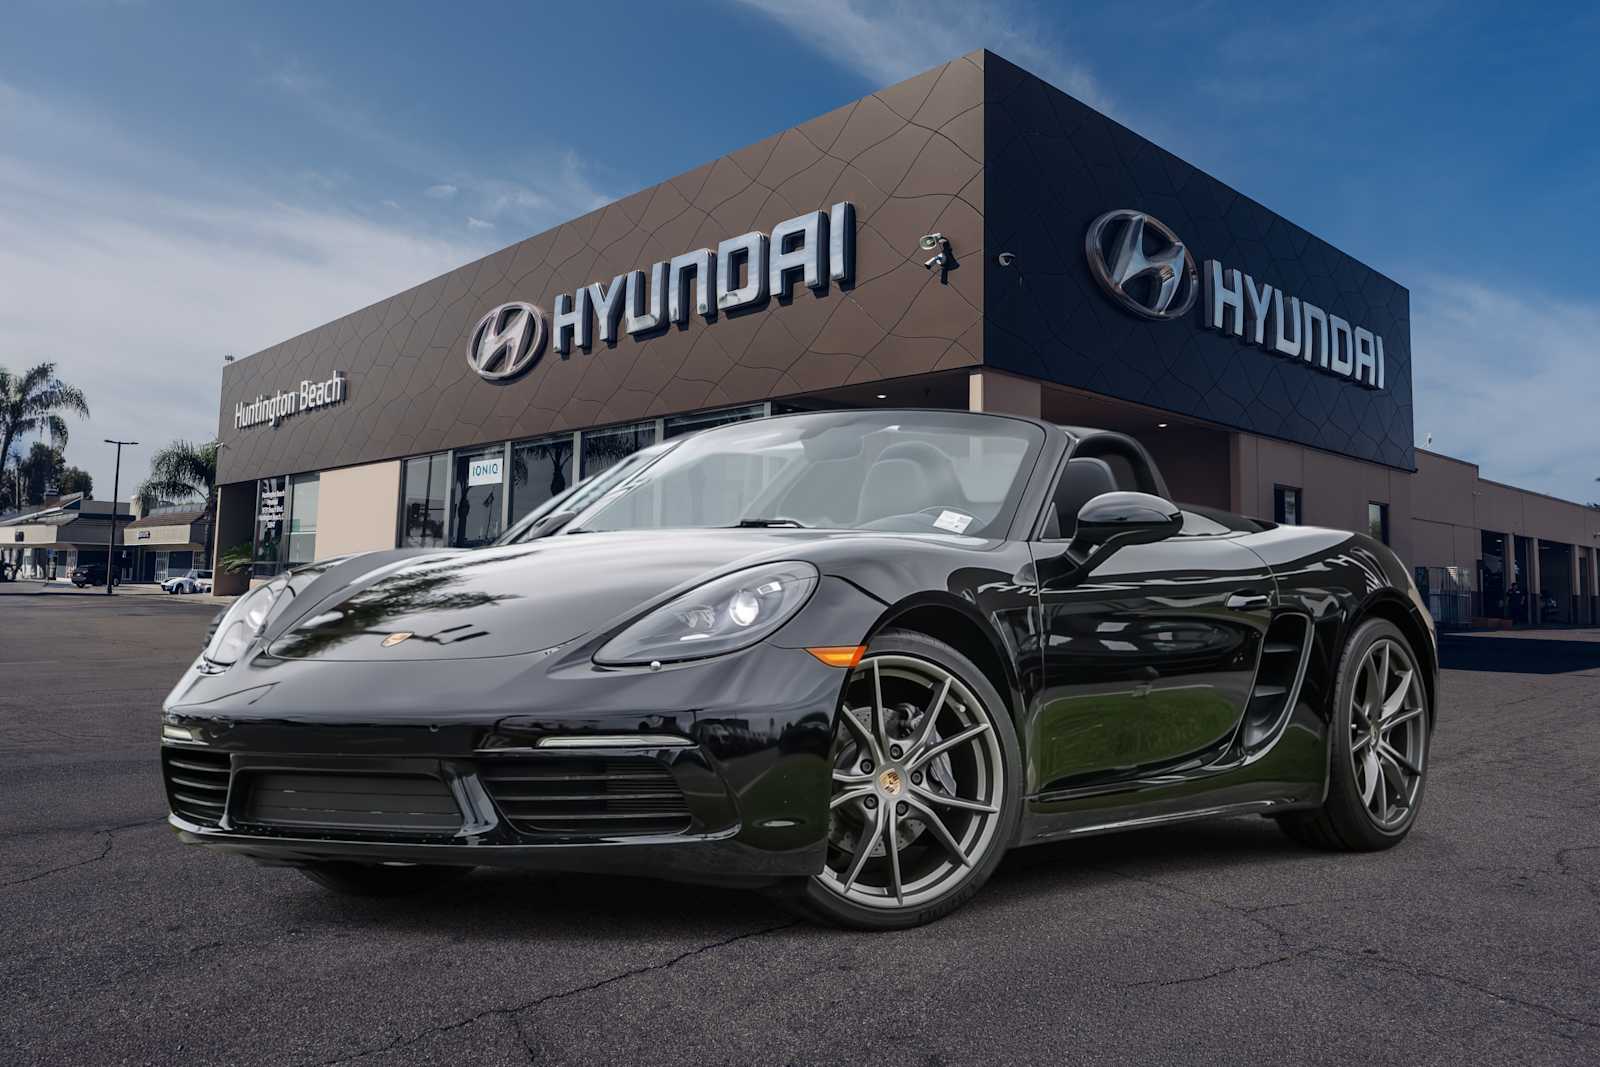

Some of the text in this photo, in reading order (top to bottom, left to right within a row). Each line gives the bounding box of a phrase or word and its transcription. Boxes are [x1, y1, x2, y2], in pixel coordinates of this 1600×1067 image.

[553, 201, 855, 356] HYUNDAI
[1205, 259, 1384, 389] HYUNDAI
[233, 369, 345, 429] Huntington Beach
[472, 463, 498, 477] IONIQ
